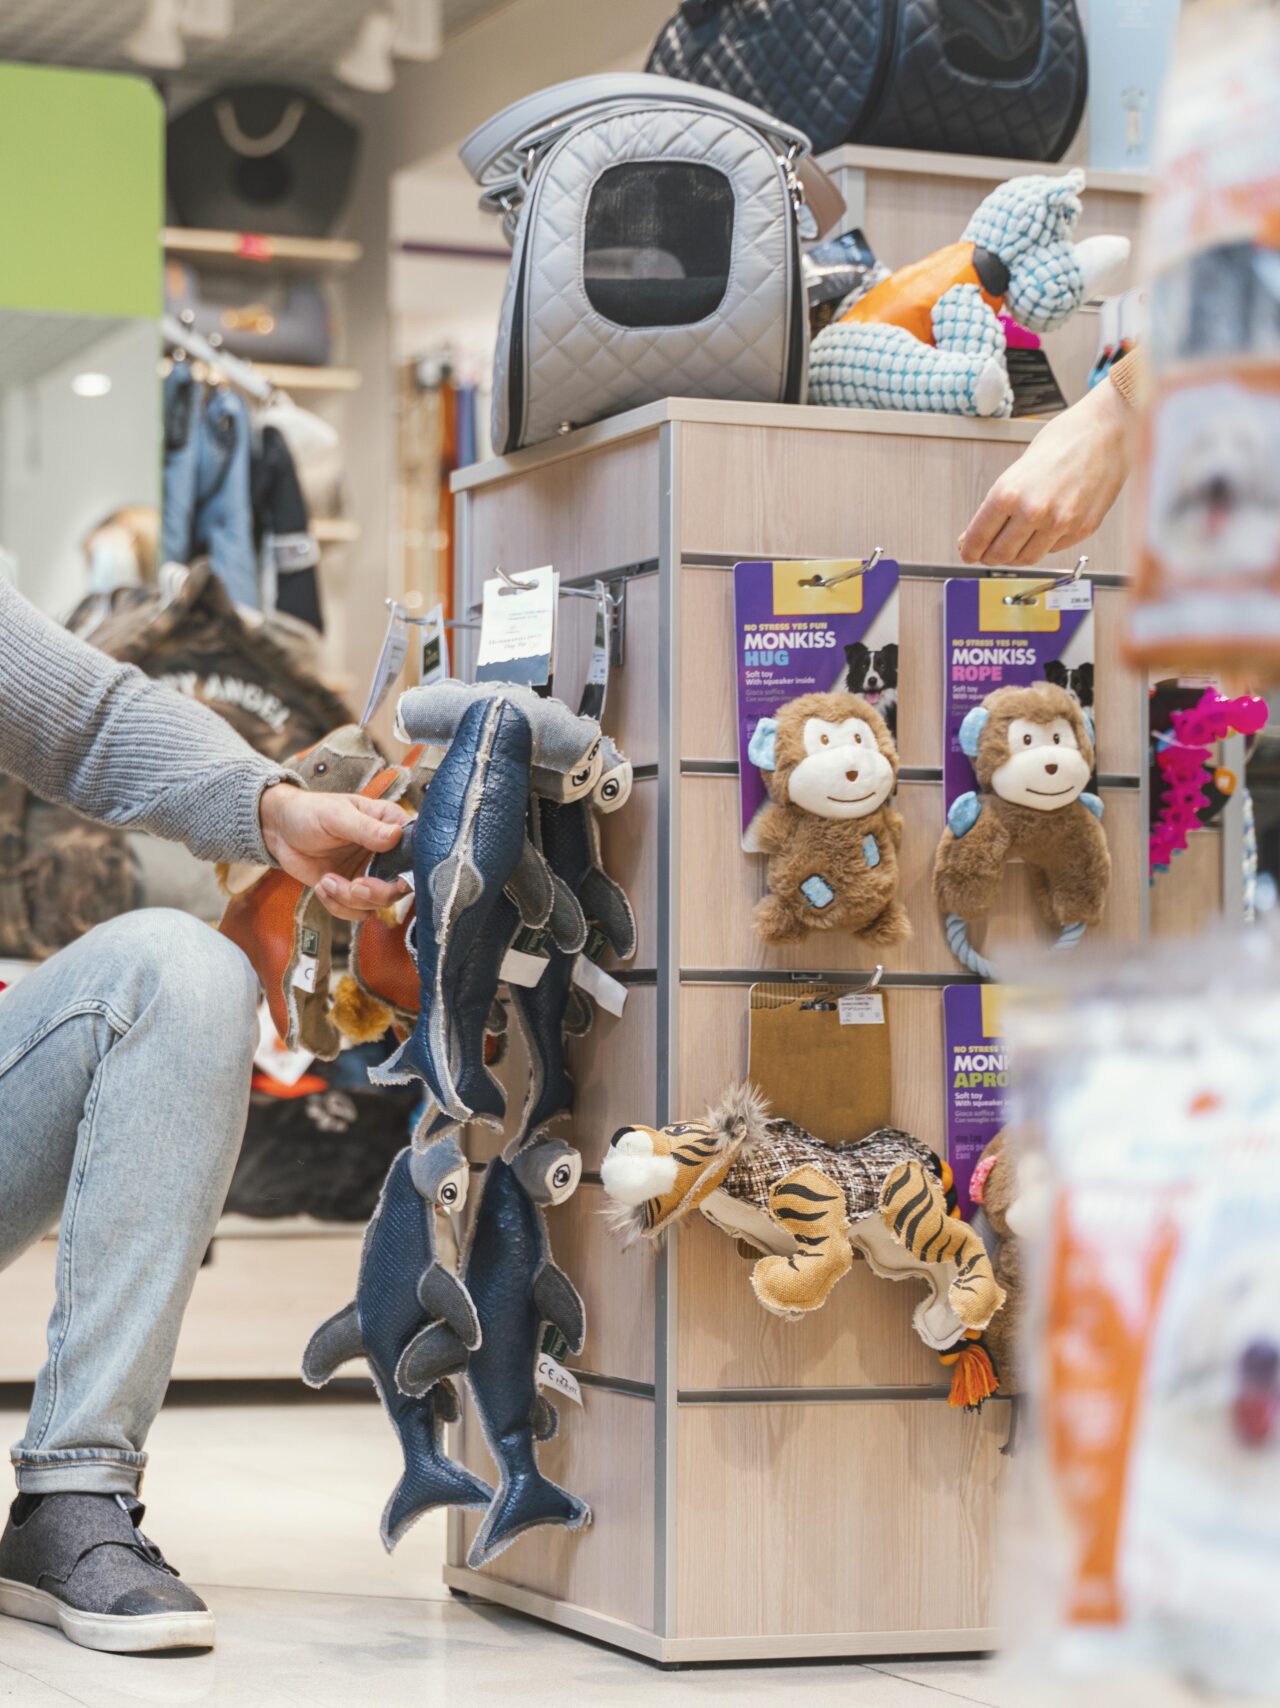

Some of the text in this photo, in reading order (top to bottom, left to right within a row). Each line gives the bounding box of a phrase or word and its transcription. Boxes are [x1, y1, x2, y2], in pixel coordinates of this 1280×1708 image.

[759, 623, 790, 631] STRESS
[792, 622, 808, 630] YES
[810, 622, 828, 630] FUN
[744, 631, 836, 649] MONKISS
[996, 639, 1010, 647] YES
[745, 650, 789, 666] HUG
[952, 648, 1036, 665] MONKISS
[761, 671, 773, 679] toy
[952, 665, 1002, 681] ROPE
[745, 678, 762, 686] With
[763, 677, 793, 686] squeaker
[953, 1046, 967, 1054] NO
[954, 1092, 983, 1101] Soft toy
[954, 1099, 972, 1107] With
